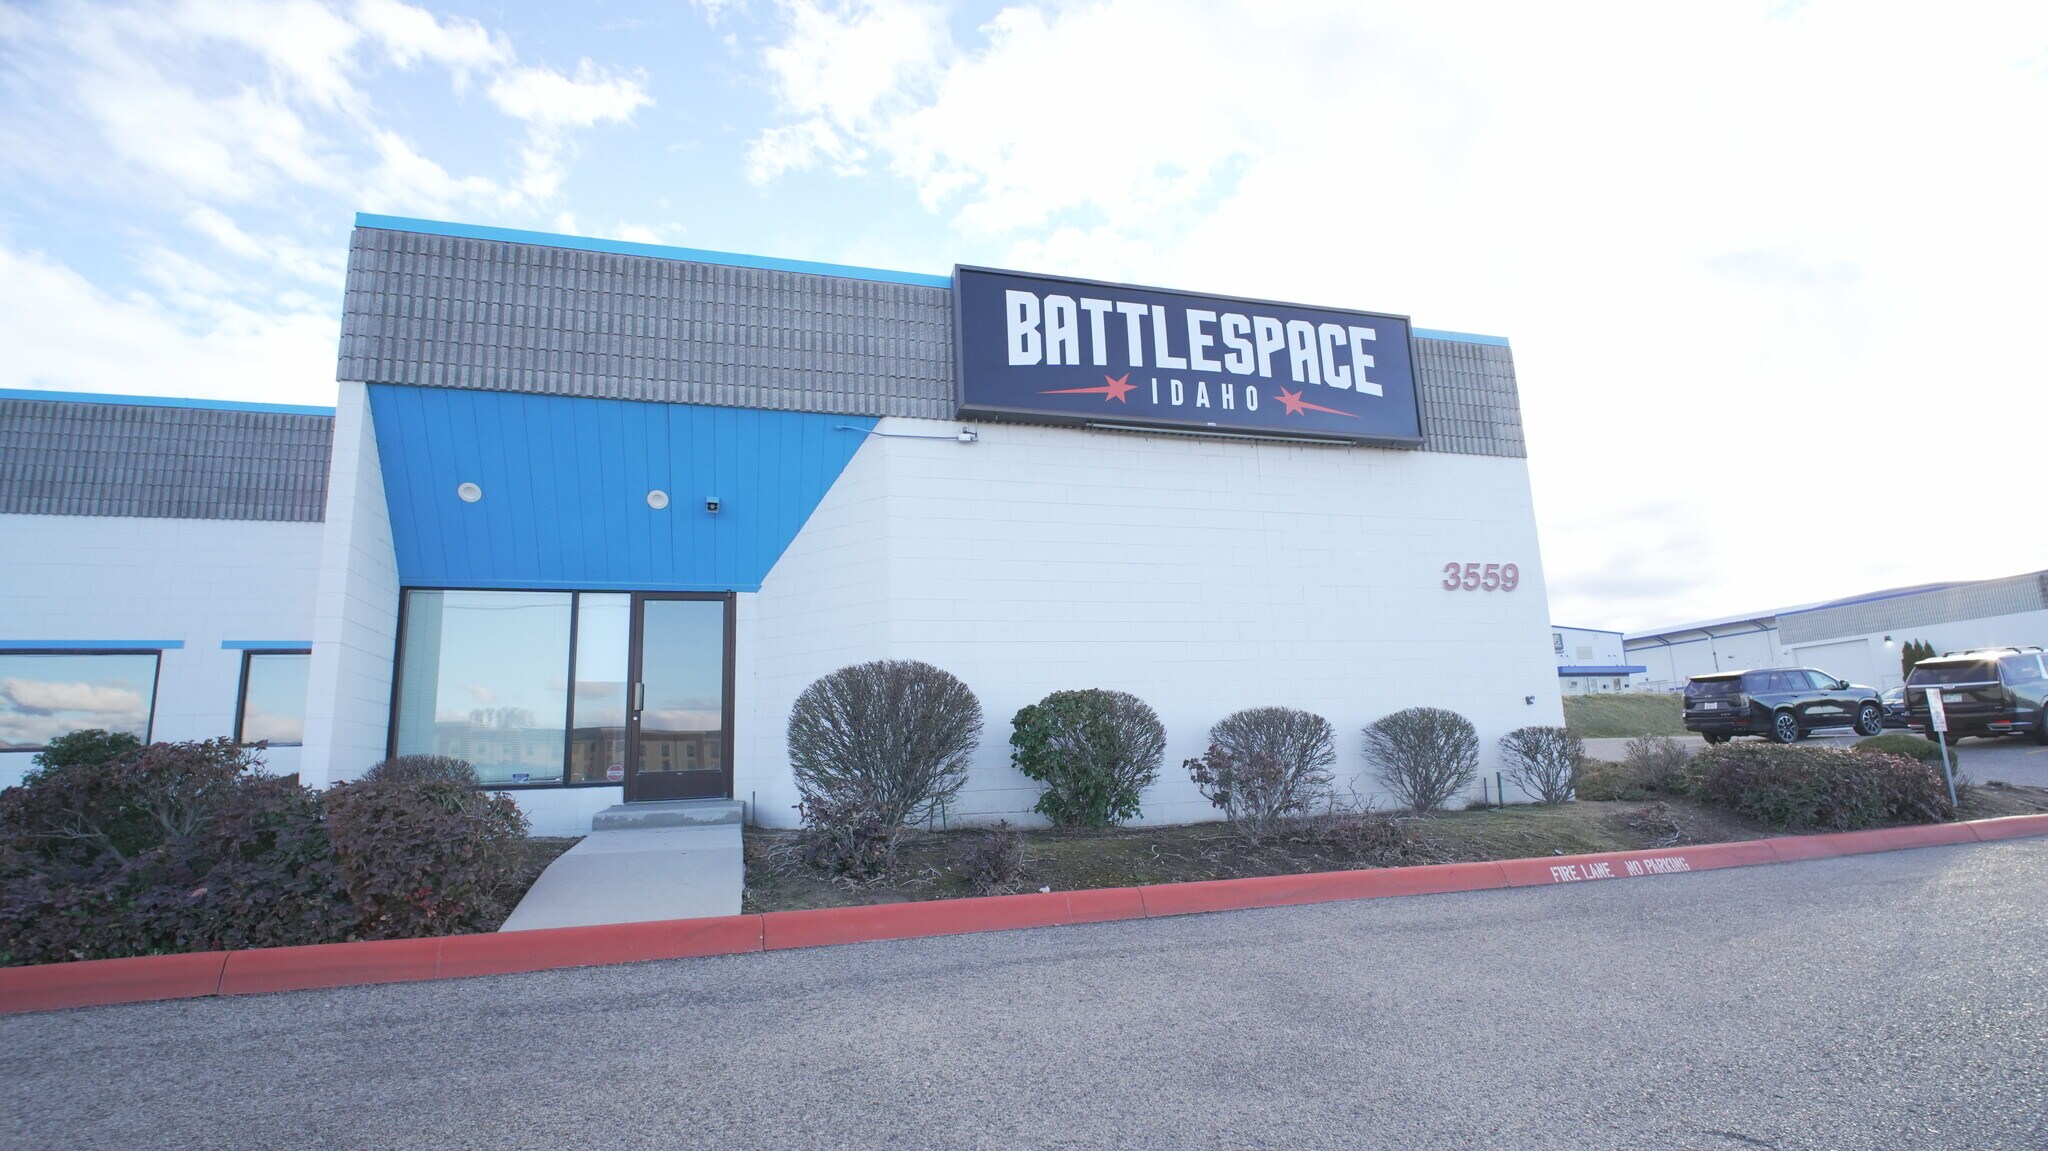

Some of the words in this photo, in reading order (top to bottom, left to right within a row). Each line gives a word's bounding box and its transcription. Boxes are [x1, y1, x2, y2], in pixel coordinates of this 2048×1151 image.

[1005, 290, 1383, 397] BATTLESPACE
[1151, 377, 1259, 412] IDAHO
[1442, 562, 1519, 592] 3559
[1550, 865, 1580, 882] FIRE
[1581, 862, 1614, 881] LANE
[1625, 860, 1643, 876] NO
[1644, 857, 1690, 874] PARKING
